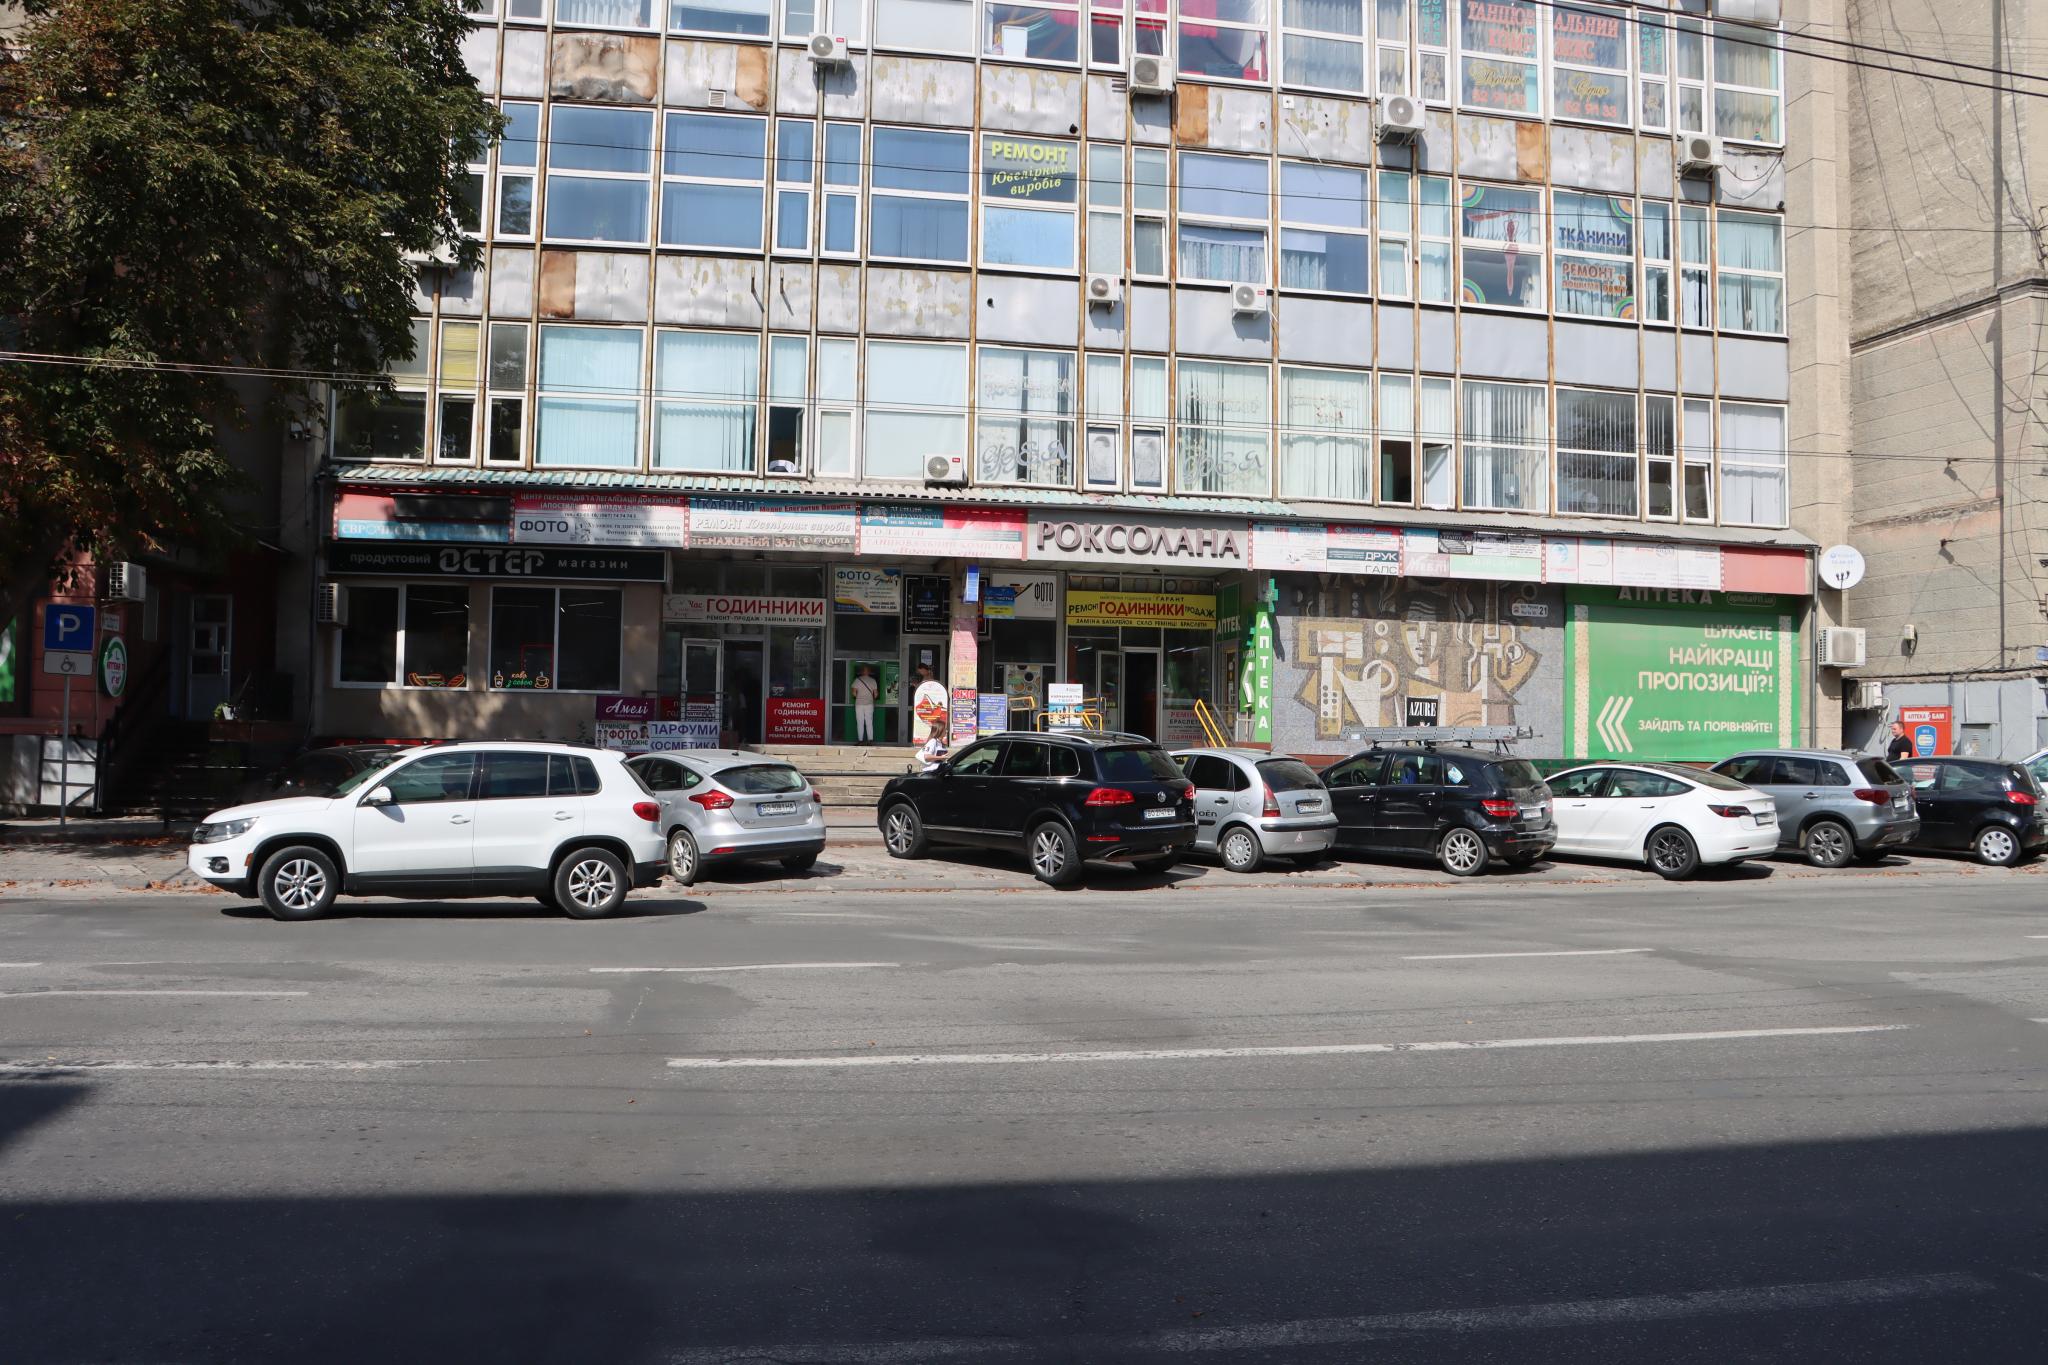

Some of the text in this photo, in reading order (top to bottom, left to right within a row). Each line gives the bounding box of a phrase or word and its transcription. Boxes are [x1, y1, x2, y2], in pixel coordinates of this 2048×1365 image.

[991, 141, 1069, 164] РЕМОНТ
[991, 165, 1068, 186] Ювелірних
[1010, 178, 1062, 196] виробів
[1558, 227, 1627, 248] ТКАНИНИ
[1562, 262, 1616, 279] РЕМОНТ
[695, 499, 755, 512] ТКАНИНИ
[519, 520, 569, 533] ФОТО
[694, 518, 744, 531] РЕМОНТ
[774, 538, 796, 549] ЗАЛ
[1037, 521, 1241, 560] РОКСОЛАНА
[350, 553, 431, 568] продуктовий
[558, 558, 628, 570] магазин
[1365, 552, 1398, 563] ДРУК
[837, 571, 871, 581] ФОТО
[1034, 582, 1054, 602] ФОТО
[1618, 586, 1713, 606] АПТЕКА
[706, 598, 824, 616] ГОДИННИКИ
[1068, 601, 1216, 618] РЕМОНТ ГОДИННИКИ ПРОДАЖ
[1539, 606, 1547, 615] 21
[58, 613, 81, 643] P
[1704, 624, 1773, 641] ШУКАЄТЕ
[1669, 644, 1773, 671] НАЙКРАЩІ
[1259, 615, 1270, 729] АПТЕКА
[1638, 670, 1774, 696] ПРОПОЗИЦІЇ?!
[605, 699, 649, 716] Амелі
[782, 701, 811, 709] РЕМОНТ
[1408, 702, 1437, 717] AZURE
[1638, 717, 1773, 734] ЗАЙДІТЬ ТА ПОРІВНЯЙТЕ!
[609, 729, 639, 740] ФОТО
